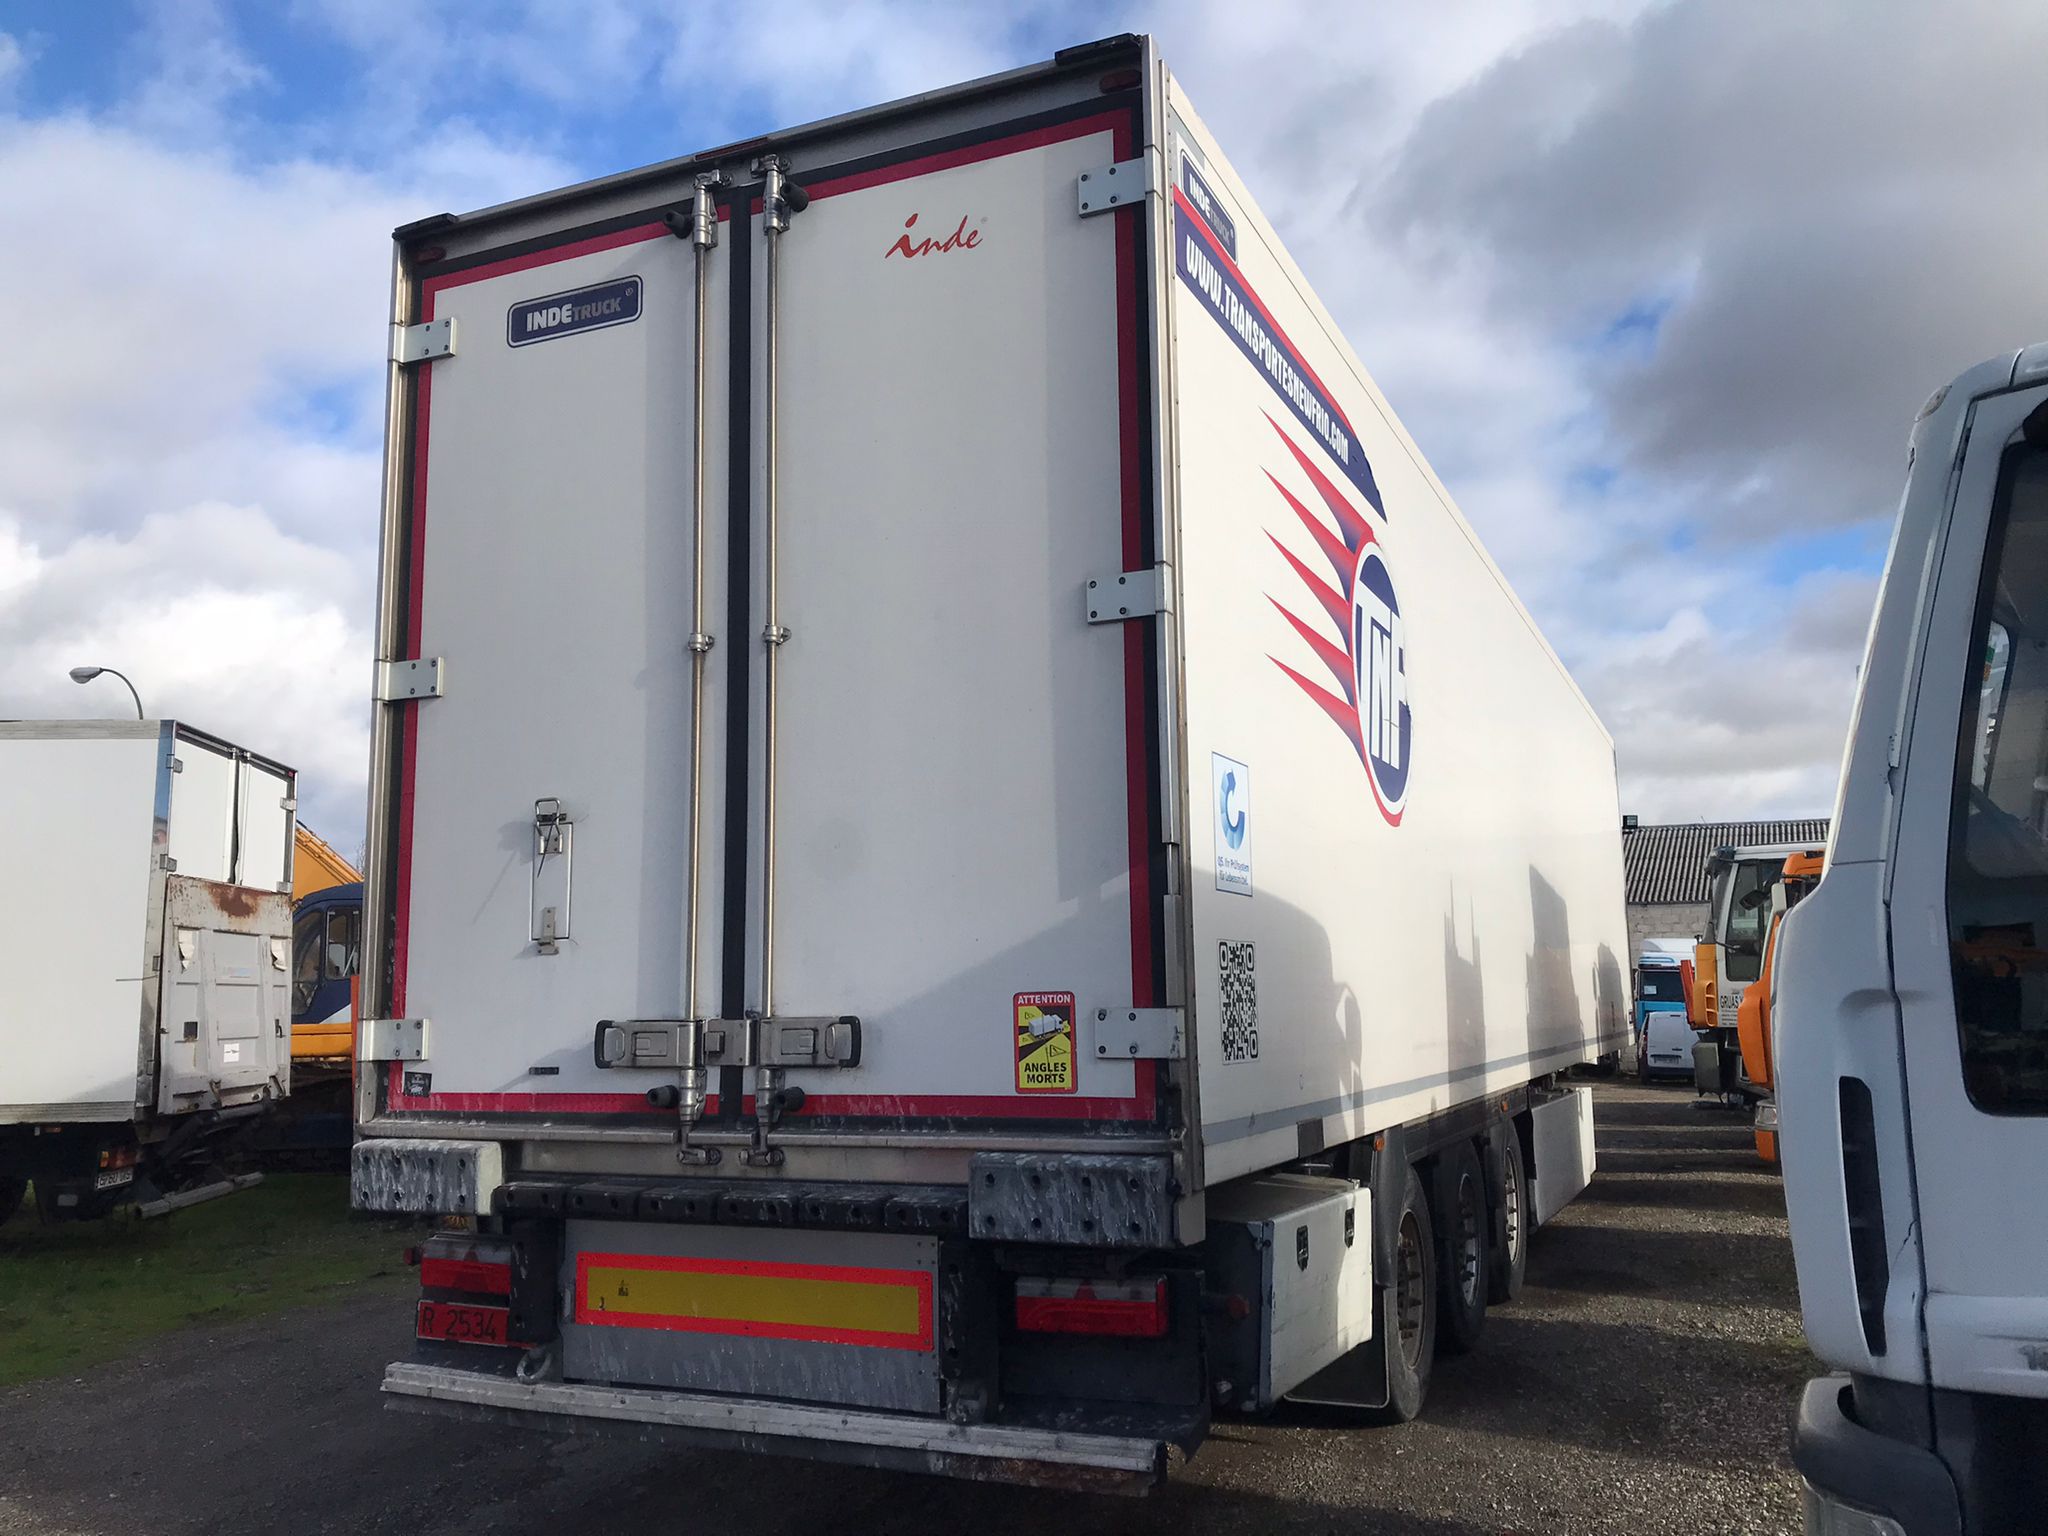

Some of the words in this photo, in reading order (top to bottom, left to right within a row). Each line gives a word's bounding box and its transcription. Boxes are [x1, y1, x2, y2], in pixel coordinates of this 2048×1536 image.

[1186, 234, 1349, 466] WWW.TRANSPORTESNEWFRIO.COM
[1018, 994, 1071, 1004] ATTENTION
[1720, 994, 1739, 1008] GRUAS
[1024, 1062, 1067, 1073] ANGLES
[1026, 1073, 1065, 1084] MORTS
[422, 1306, 435, 1334] R
[445, 1309, 497, 1339] 2534
